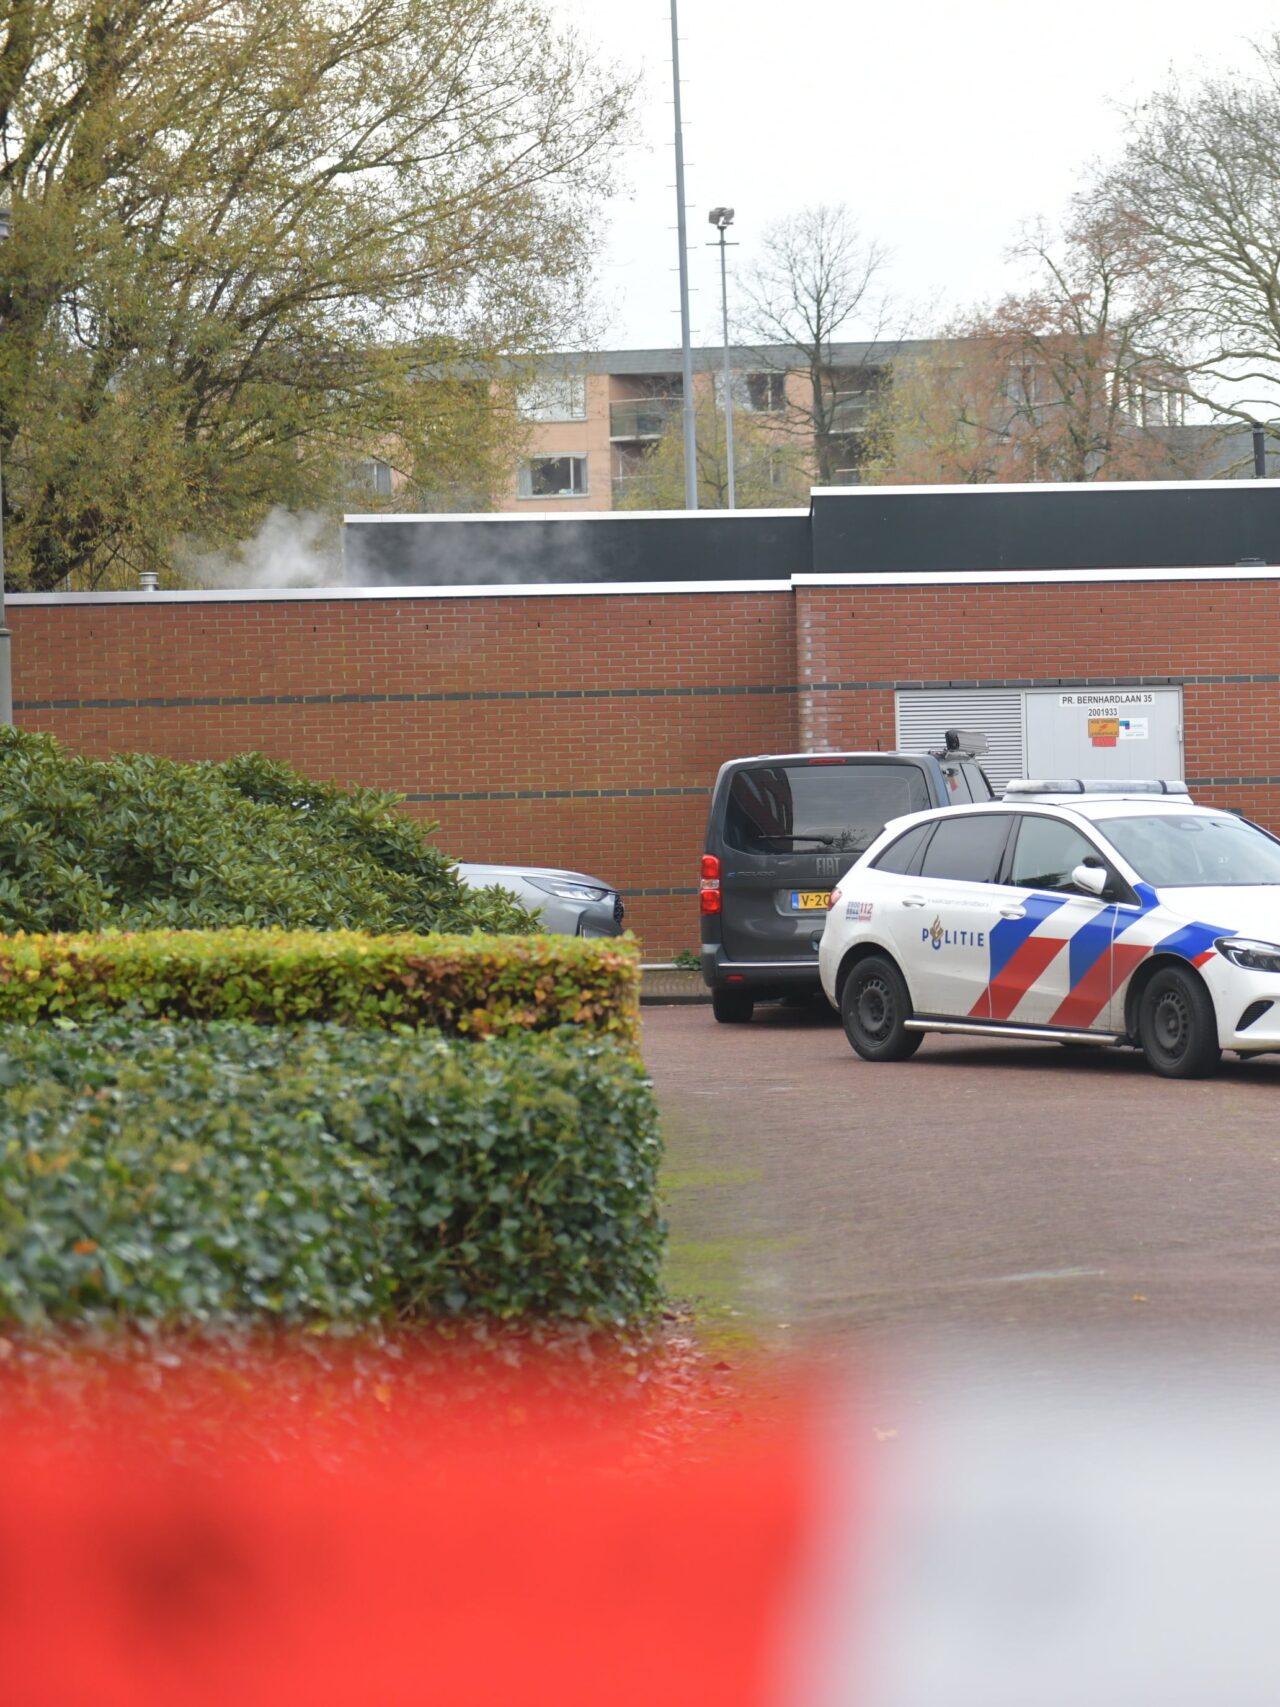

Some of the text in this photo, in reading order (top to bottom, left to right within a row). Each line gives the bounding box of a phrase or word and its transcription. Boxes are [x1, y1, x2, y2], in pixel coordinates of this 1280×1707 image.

[1062, 694, 1153, 705] PR. BERNHARDLAAN 35
[1088, 707, 1118, 717] 2001933
[815, 857, 841, 877] FIAT
[860, 902, 874, 915] 112
[922, 927, 985, 950] POLITIE
